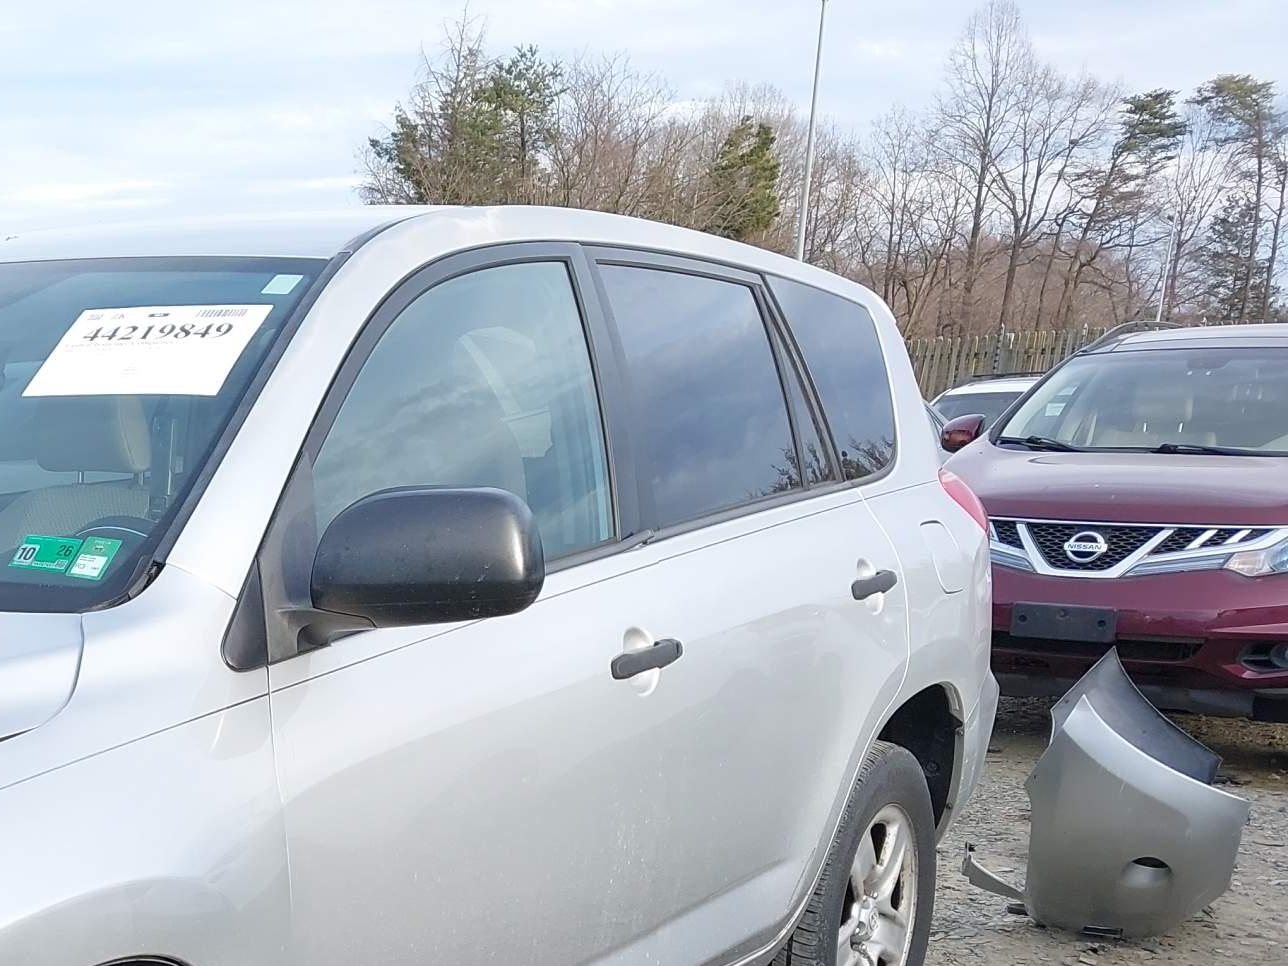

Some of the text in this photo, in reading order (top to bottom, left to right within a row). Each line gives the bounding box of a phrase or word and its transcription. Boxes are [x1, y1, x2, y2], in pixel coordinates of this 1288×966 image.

[83, 322, 234, 342] 44219849
[17, 546, 37, 561] 10
[56, 544, 74, 557] 26
[1067, 543, 1102, 551] NISSAN
